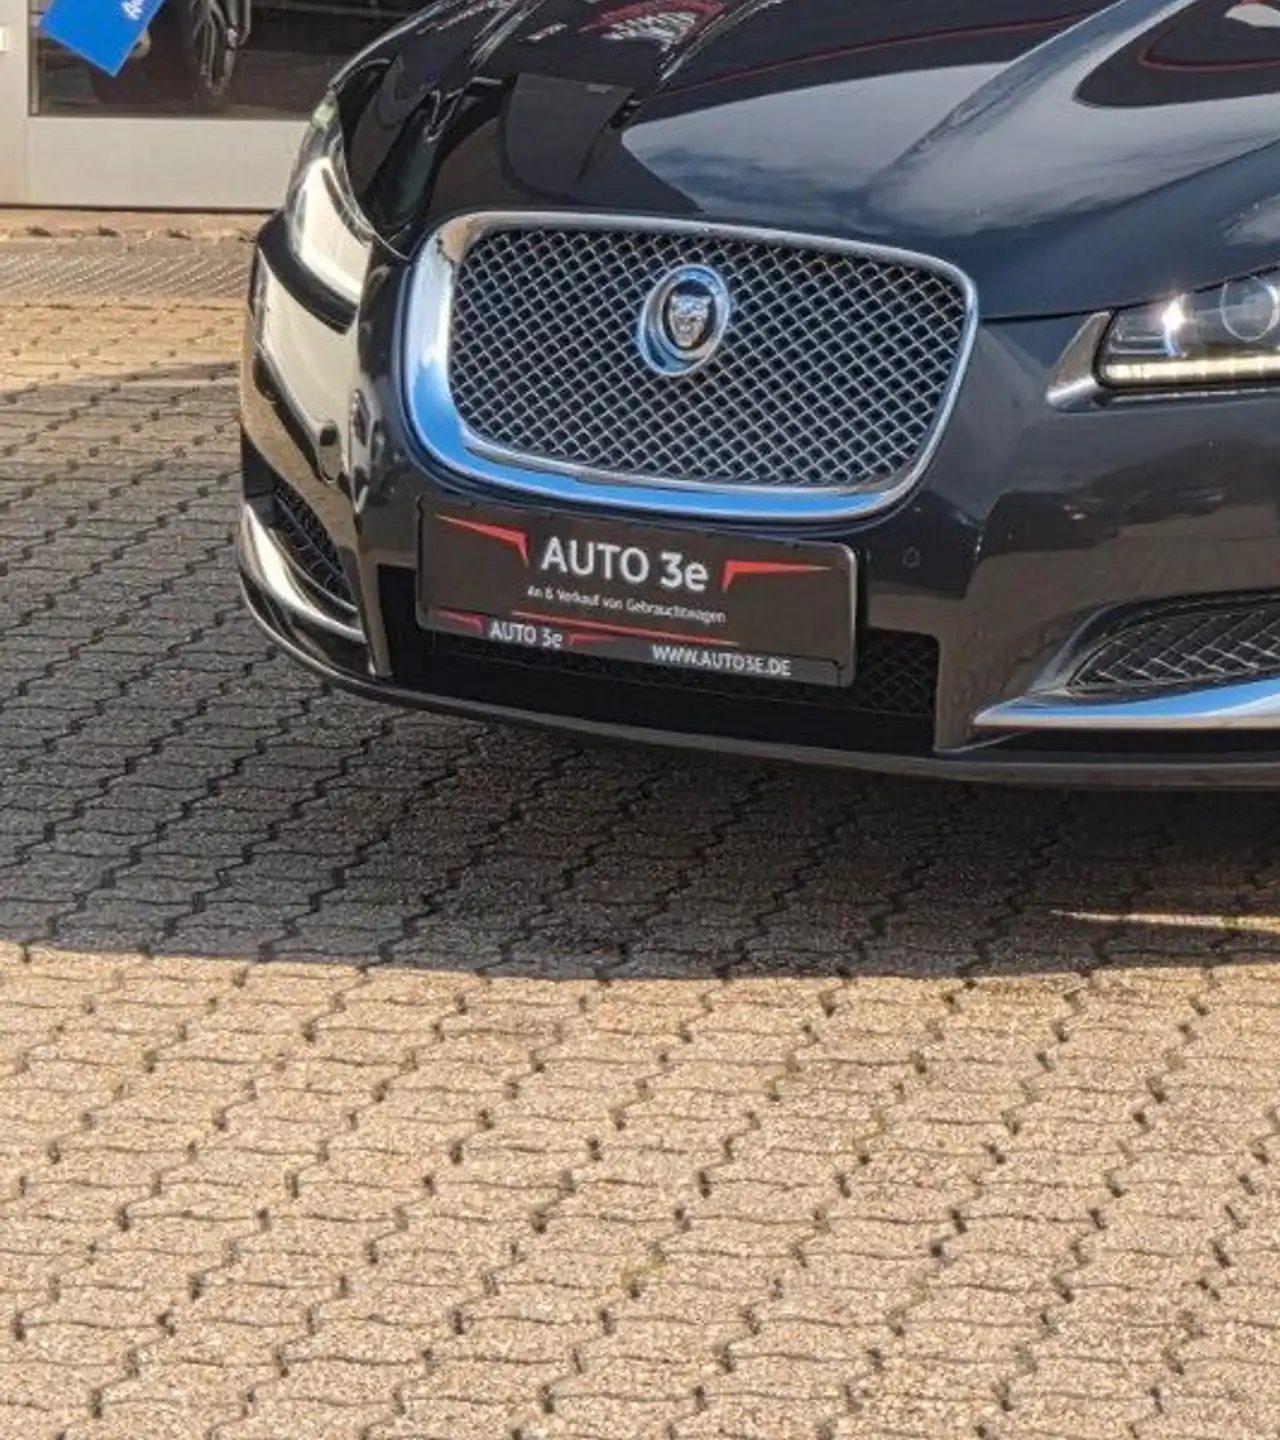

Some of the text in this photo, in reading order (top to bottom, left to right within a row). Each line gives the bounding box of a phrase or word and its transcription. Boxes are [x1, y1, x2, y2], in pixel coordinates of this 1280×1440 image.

[540, 536, 709, 593] AUTO 3e
[602, 595, 624, 610] von
[490, 620, 564, 649] AUTO 3e
[652, 644, 792, 677] WWW.AUTO3E.DE
